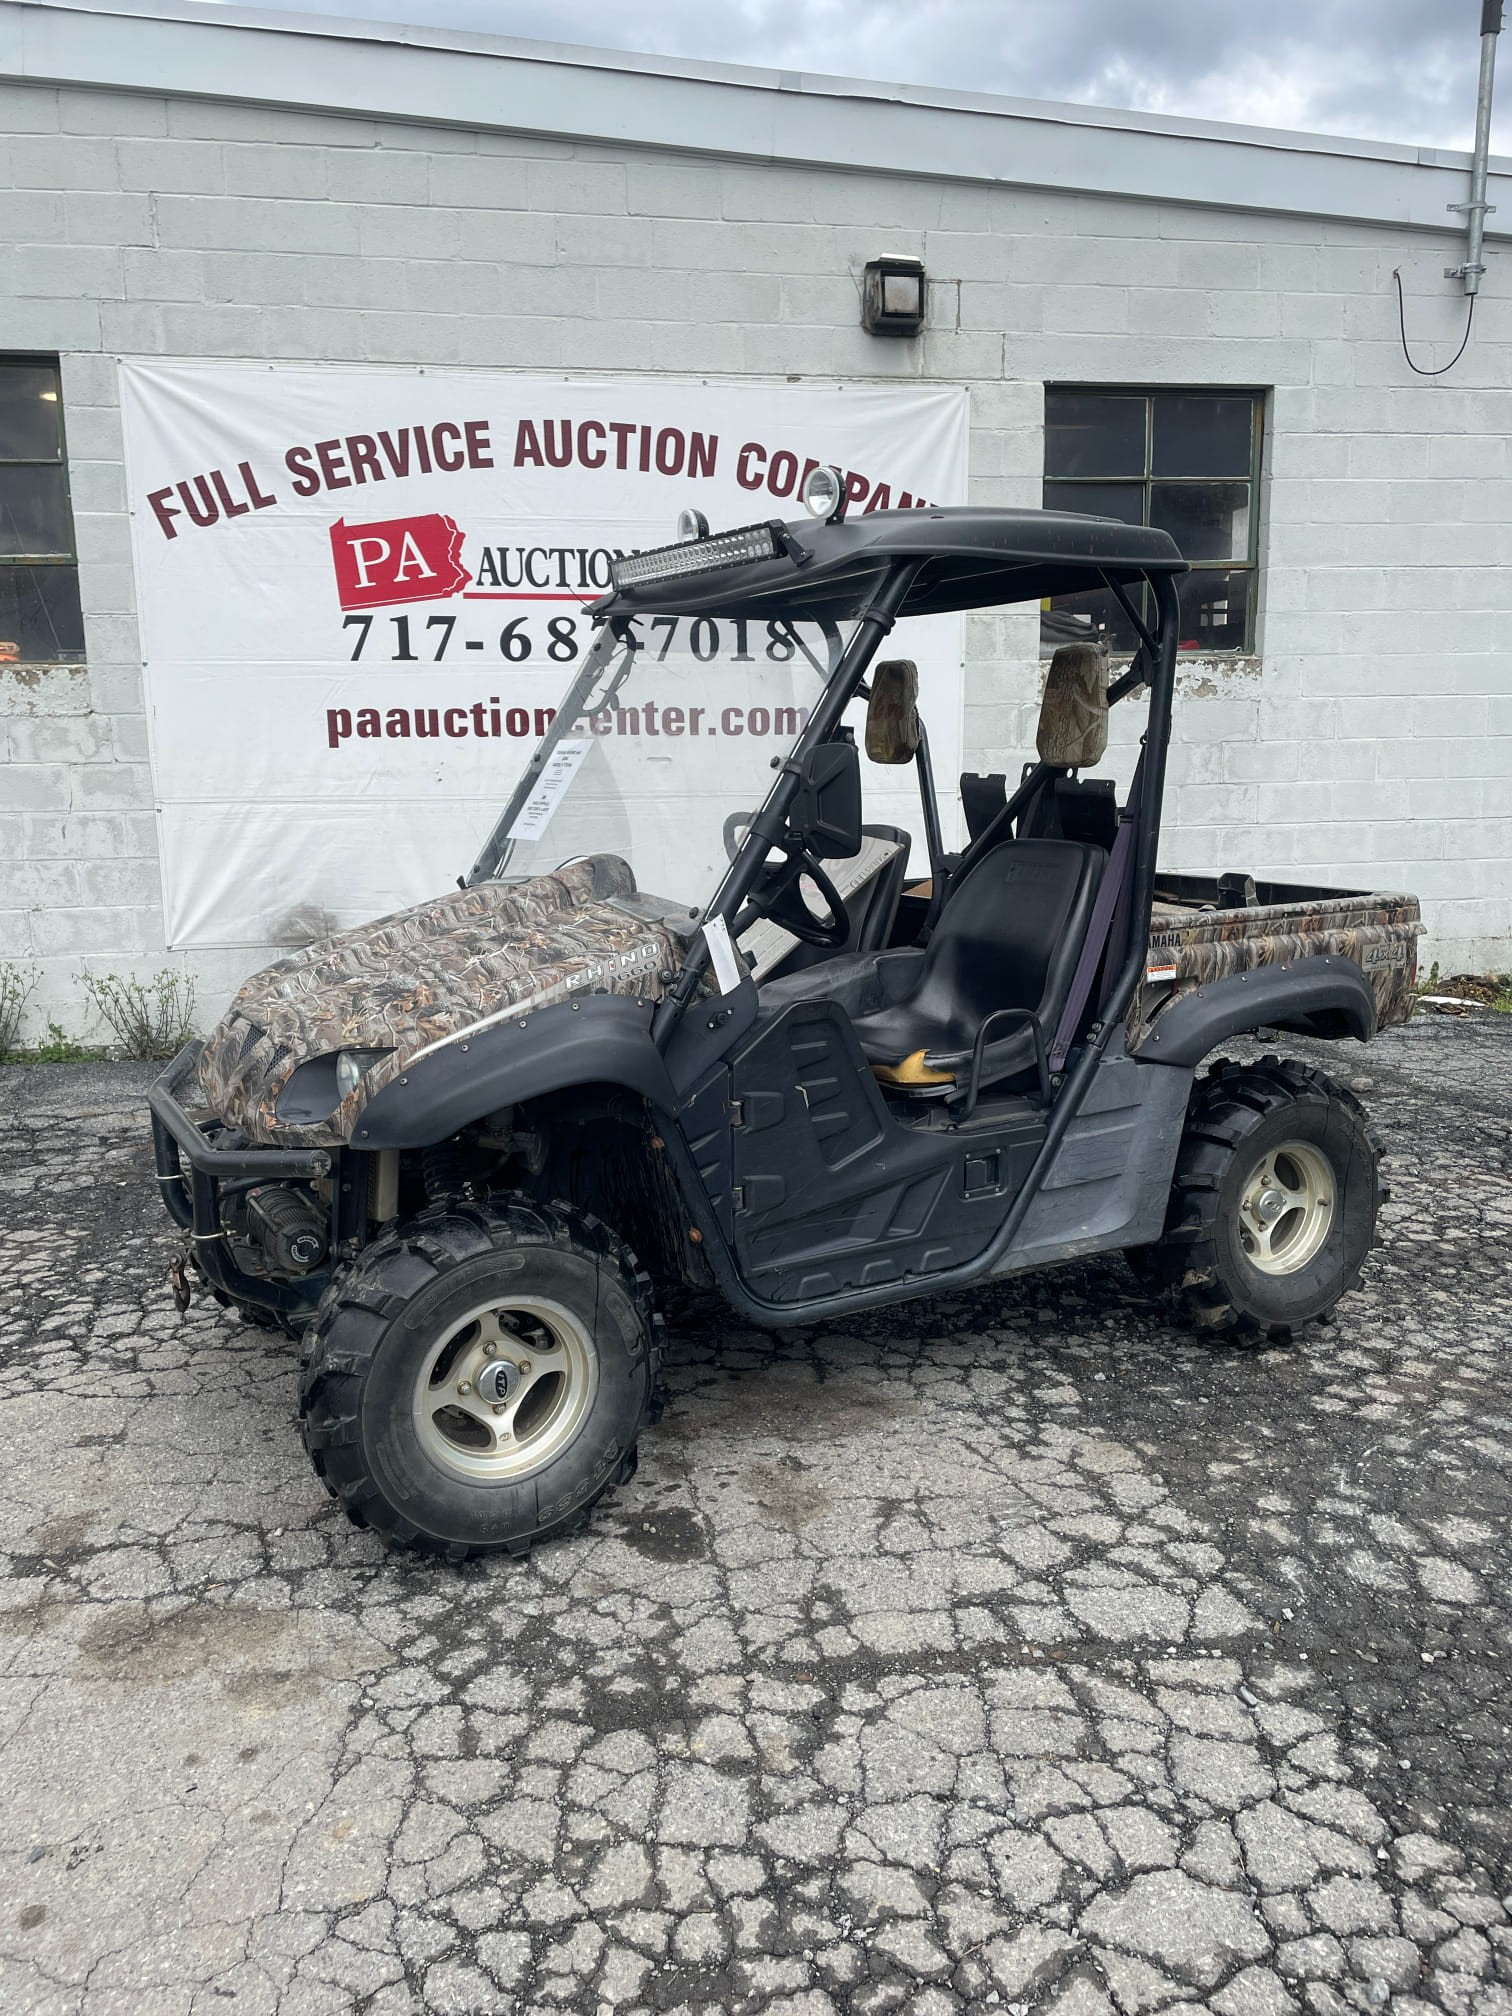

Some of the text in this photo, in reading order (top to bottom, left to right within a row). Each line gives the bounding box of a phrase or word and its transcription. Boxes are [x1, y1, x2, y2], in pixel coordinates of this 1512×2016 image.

[146, 419, 940, 541] FULL SERVICE AUCTION COPA
[346, 530, 641, 589] PA AUCTIO
[341, 614, 795, 663] 717-68-7018
[326, 696, 810, 749] paauctionenter.com
[1149, 933, 1182, 949] MAHA
[1365, 945, 1405, 965] 4x4
[565, 942, 660, 991] RHINO
[617, 960, 657, 982] 660
